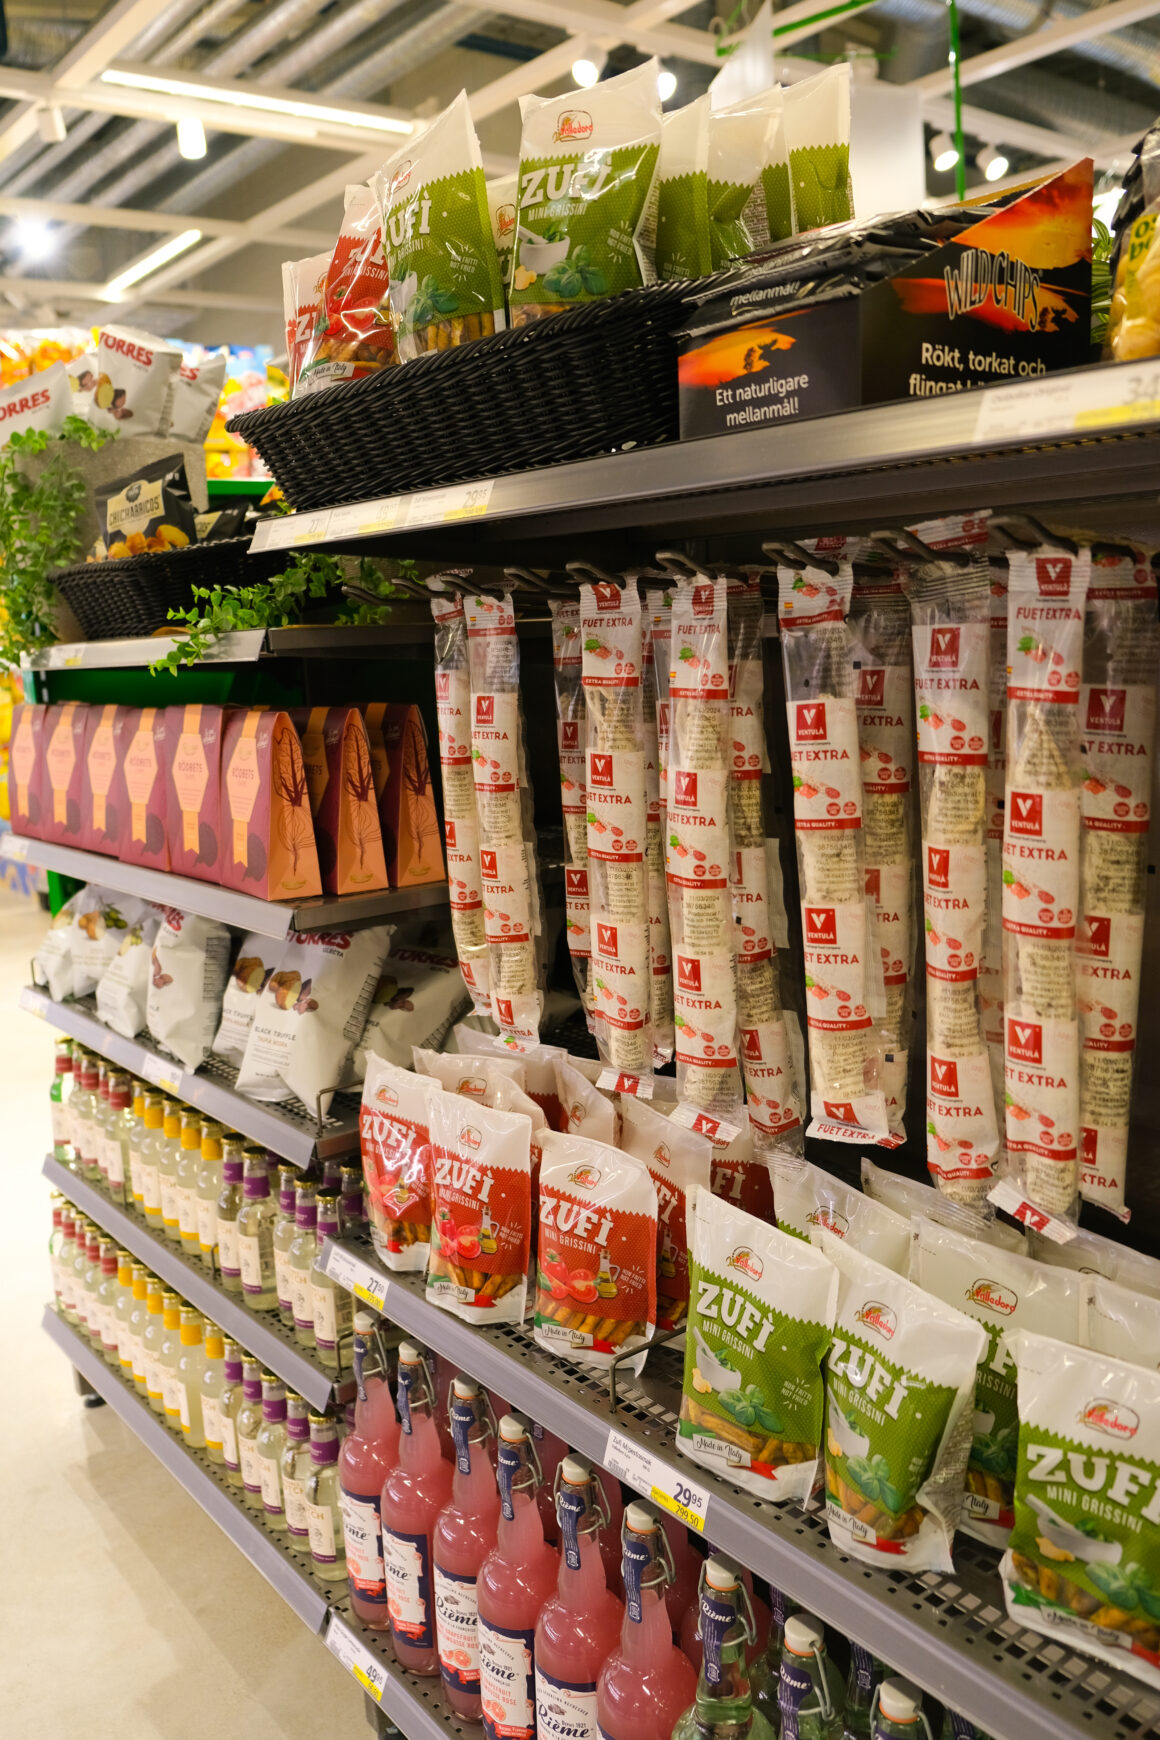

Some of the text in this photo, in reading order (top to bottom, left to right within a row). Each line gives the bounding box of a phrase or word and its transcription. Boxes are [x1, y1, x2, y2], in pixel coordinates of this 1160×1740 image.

[944, 248, 1040, 333] WILD CHIPS
[921, 342, 1046, 377] Rökt, torkat och
[716, 374, 809, 406] Ett naturligare
[726, 396, 799, 427] mellanmål!
[1016, 607, 1081, 621] FUET EXTRA
[582, 617, 633, 628] FUET EXTRA
[677, 624, 721, 635] FUET EXTRA
[937, 678, 980, 691] EXTRA
[482, 731, 509, 741] EXTRA
[807, 749, 849, 761] EXTRA
[1100, 741, 1147, 756] EXTRA
[599, 794, 632, 805] EXTRA
[681, 816, 716, 827] EXTRA
[1020, 848, 1068, 861] EXTRA
[487, 885, 514, 894] EXTRA
[933, 897, 970, 909] EXTRA
[817, 953, 859, 965] EXTRA
[606, 962, 636, 976] EXTRA
[687, 1000, 722, 1010] EXTRA
[1019, 1072, 1067, 1088] EXTRA
[938, 1105, 983, 1117] EXTRA
[817, 1124, 842, 1135] FUET
[435, 1158, 495, 1204] ZUFÌ
[451, 1193, 480, 1211] GRISSINI
[539, 1196, 613, 1247] ZUFÌ
[559, 1235, 597, 1255] GRISSINI
[696, 1280, 775, 1353] ZUFÌ
[702, 1319, 755, 1360] MINI GRISSINI
[976, 1370, 1016, 1399] RISSINI
[833, 1378, 886, 1426] MINI GRISSINI
[696, 1437, 743, 1463] Made in Italy
[966, 1495, 989, 1514] Italy
[1047, 1486, 1143, 1534] MINI GRISSINI
[481, 1655, 516, 1681] ième
[537, 1703, 590, 1738] Rième
